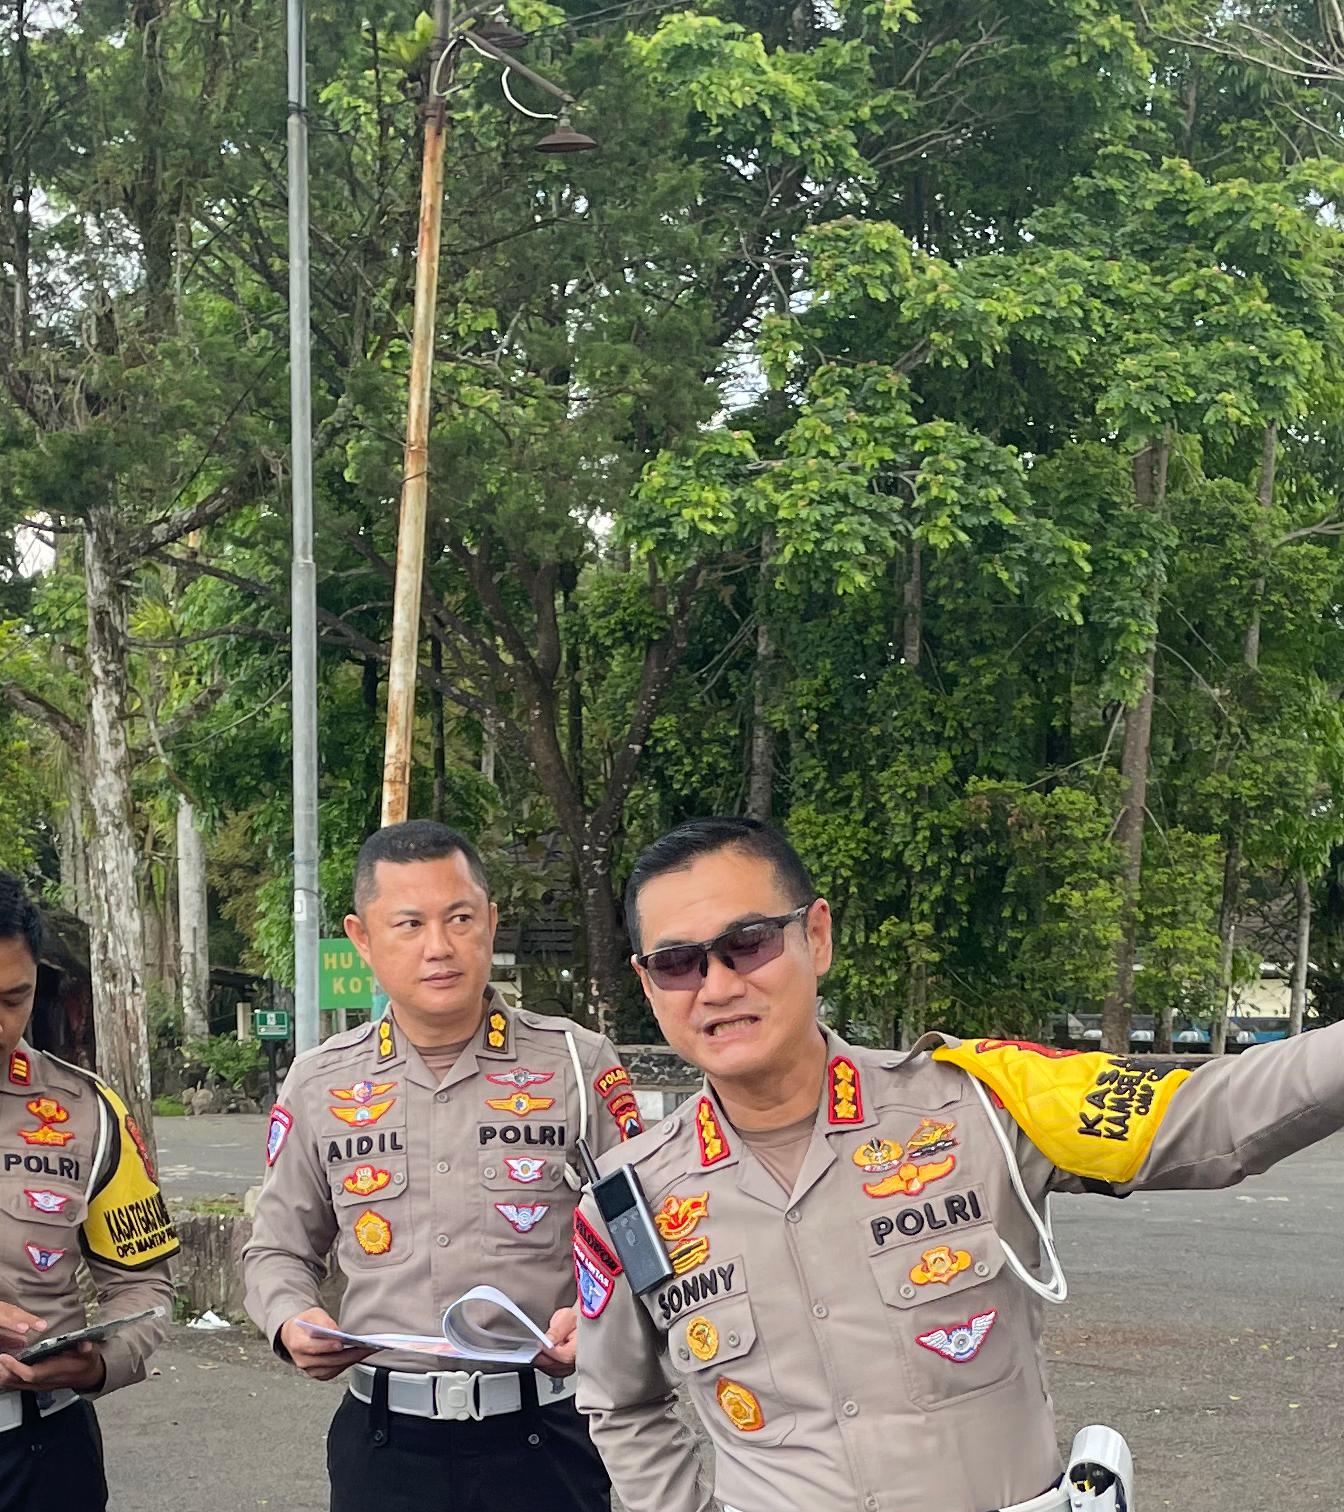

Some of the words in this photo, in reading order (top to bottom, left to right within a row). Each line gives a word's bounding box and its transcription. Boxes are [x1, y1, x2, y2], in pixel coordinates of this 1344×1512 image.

[327, 1131, 403, 1163] AIDIL
[479, 1125, 565, 1146] POLRI
[4, 1153, 80, 1181] POLRI
[870, 1190, 982, 1246] POLRI
[116, 1242, 136, 1258] OPS
[657, 1263, 735, 1320] SONNY
